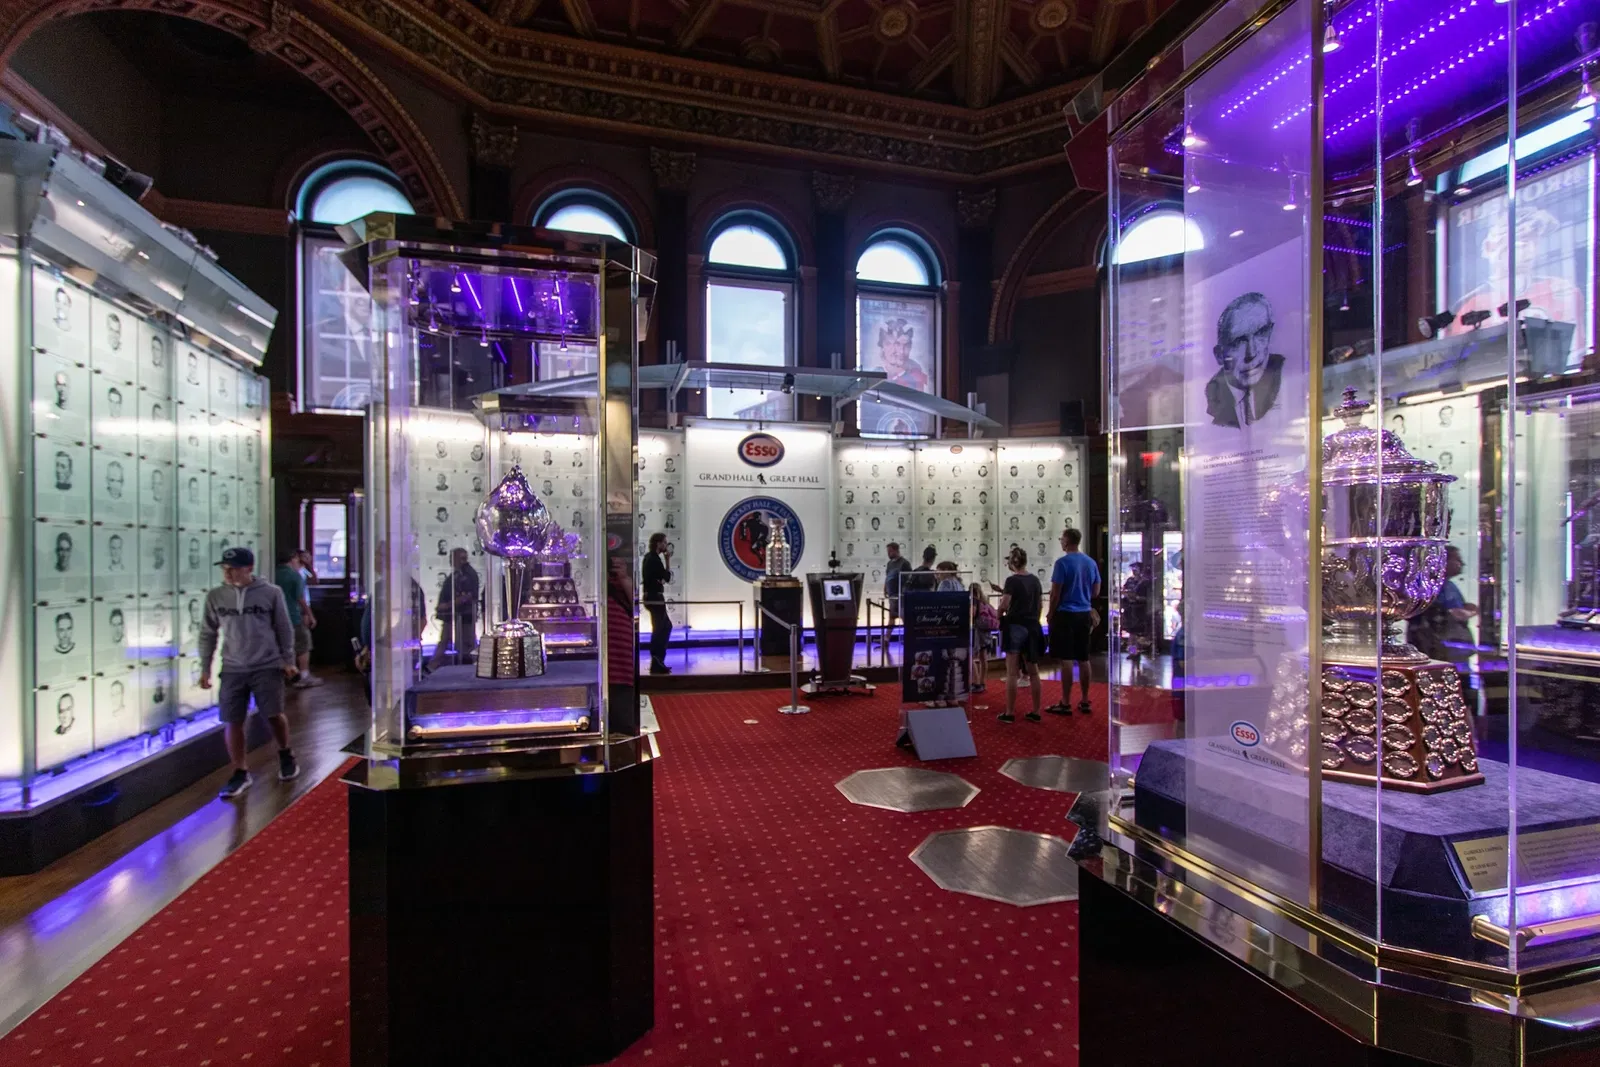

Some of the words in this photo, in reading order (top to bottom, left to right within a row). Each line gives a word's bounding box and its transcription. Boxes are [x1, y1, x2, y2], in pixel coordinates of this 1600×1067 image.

[745, 442, 778, 457] Esso
[699, 473, 732, 482] GRAND
[798, 476, 820, 484] HALL
[752, 500, 771, 508] HALL
[1236, 727, 1256, 740] Esso
[1208, 741, 1227, 752] GRAND
[1250, 753, 1268, 764] GREAT
[1270, 758, 1286, 768] HALL
